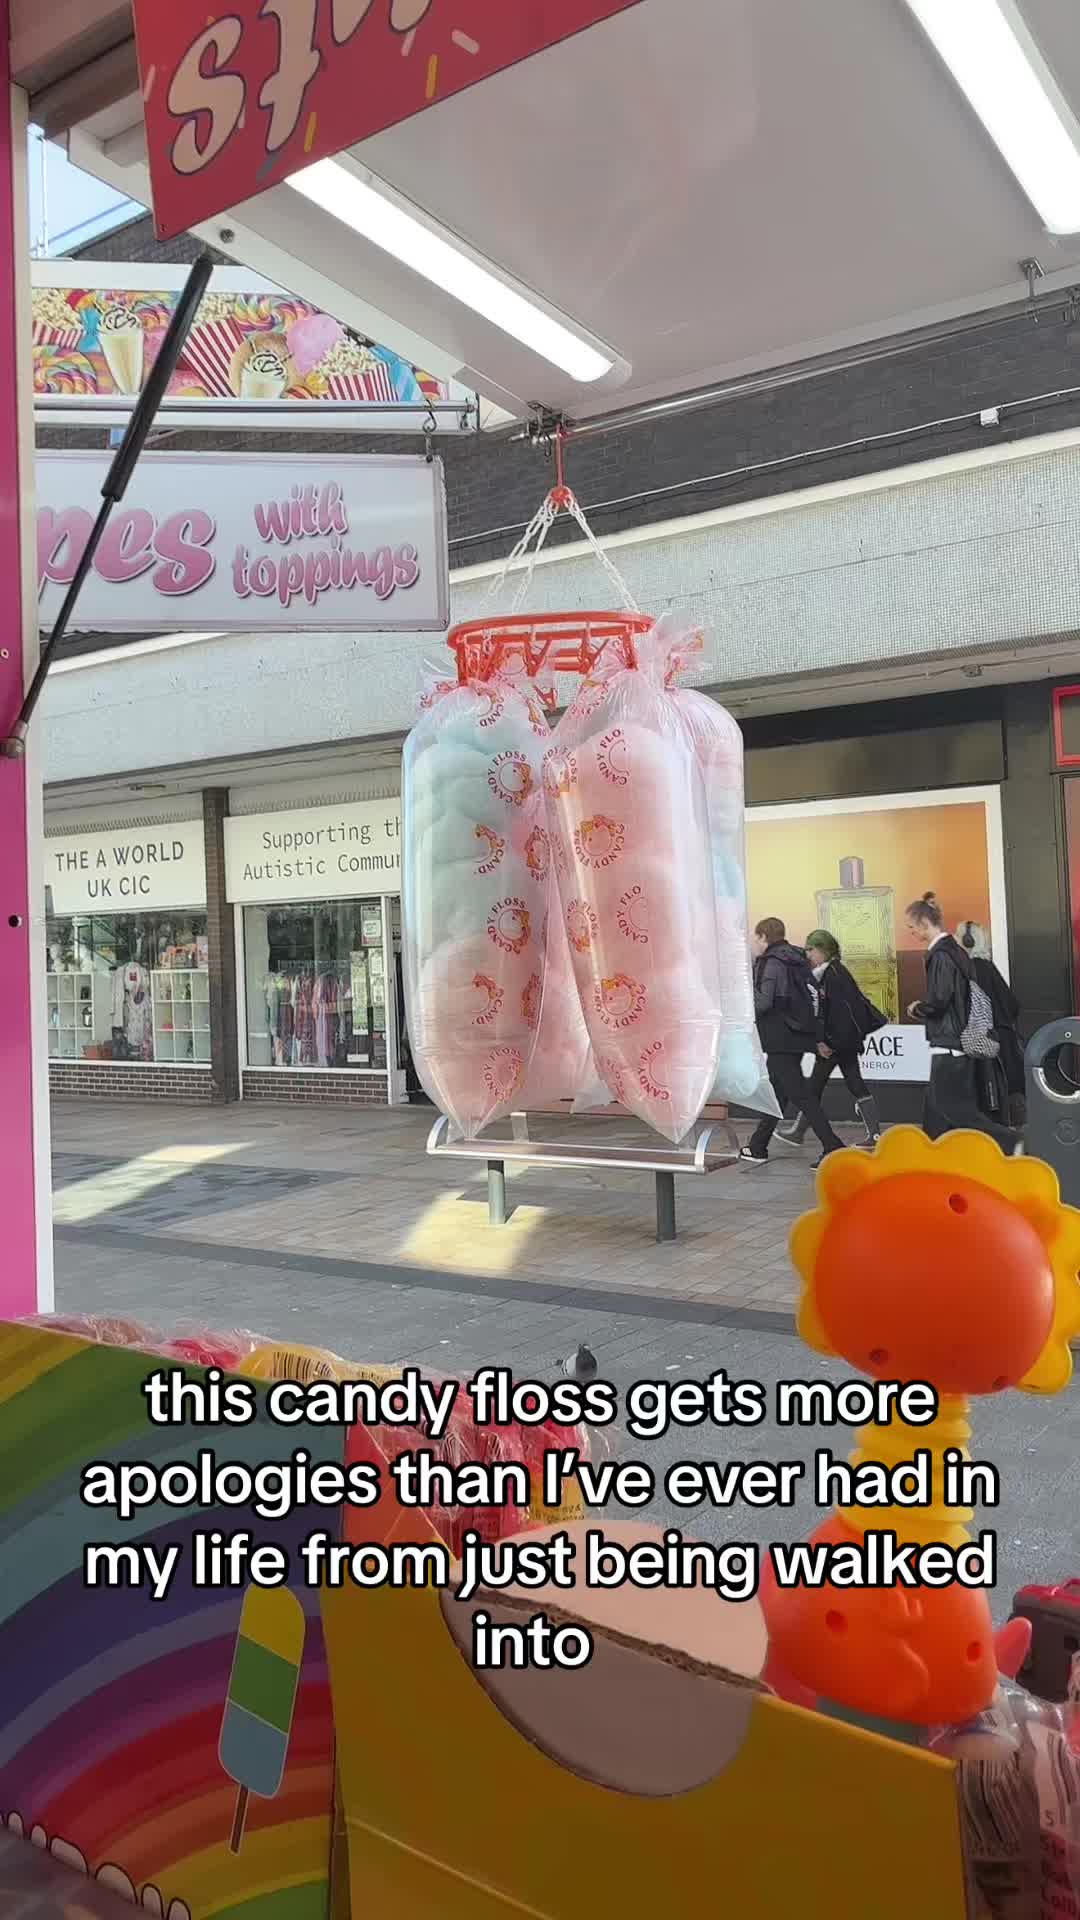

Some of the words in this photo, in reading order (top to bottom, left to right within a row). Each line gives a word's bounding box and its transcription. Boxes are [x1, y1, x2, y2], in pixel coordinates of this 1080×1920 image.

[253, 481, 349, 544] with
[232, 538, 421, 608] toppings
[477, 702, 505, 728] CAND
[600, 729, 624, 749] FLO
[492, 750, 527, 766] FLOSS
[596, 753, 628, 786] CANDY
[487, 769, 513, 804] CANDY
[262, 822, 371, 852] Supporting
[55, 851, 89, 872] THE
[96, 848, 107, 869] A
[113, 841, 184, 865] WORLD
[475, 846, 504, 875] CAND
[593, 836, 625, 869] CANDY
[243, 856, 326, 881] Autistic
[87, 878, 112, 898] UK
[119, 875, 151, 896] CIC
[491, 897, 526, 914] FLOSS
[486, 917, 512, 952] CANDY
[616, 911, 649, 944] CANDY
[472, 999, 503, 1025] CAND
[614, 996, 646, 1029] CANDY
[863, 1035, 905, 1057] ACE
[638, 1067, 669, 1100] CANDY
